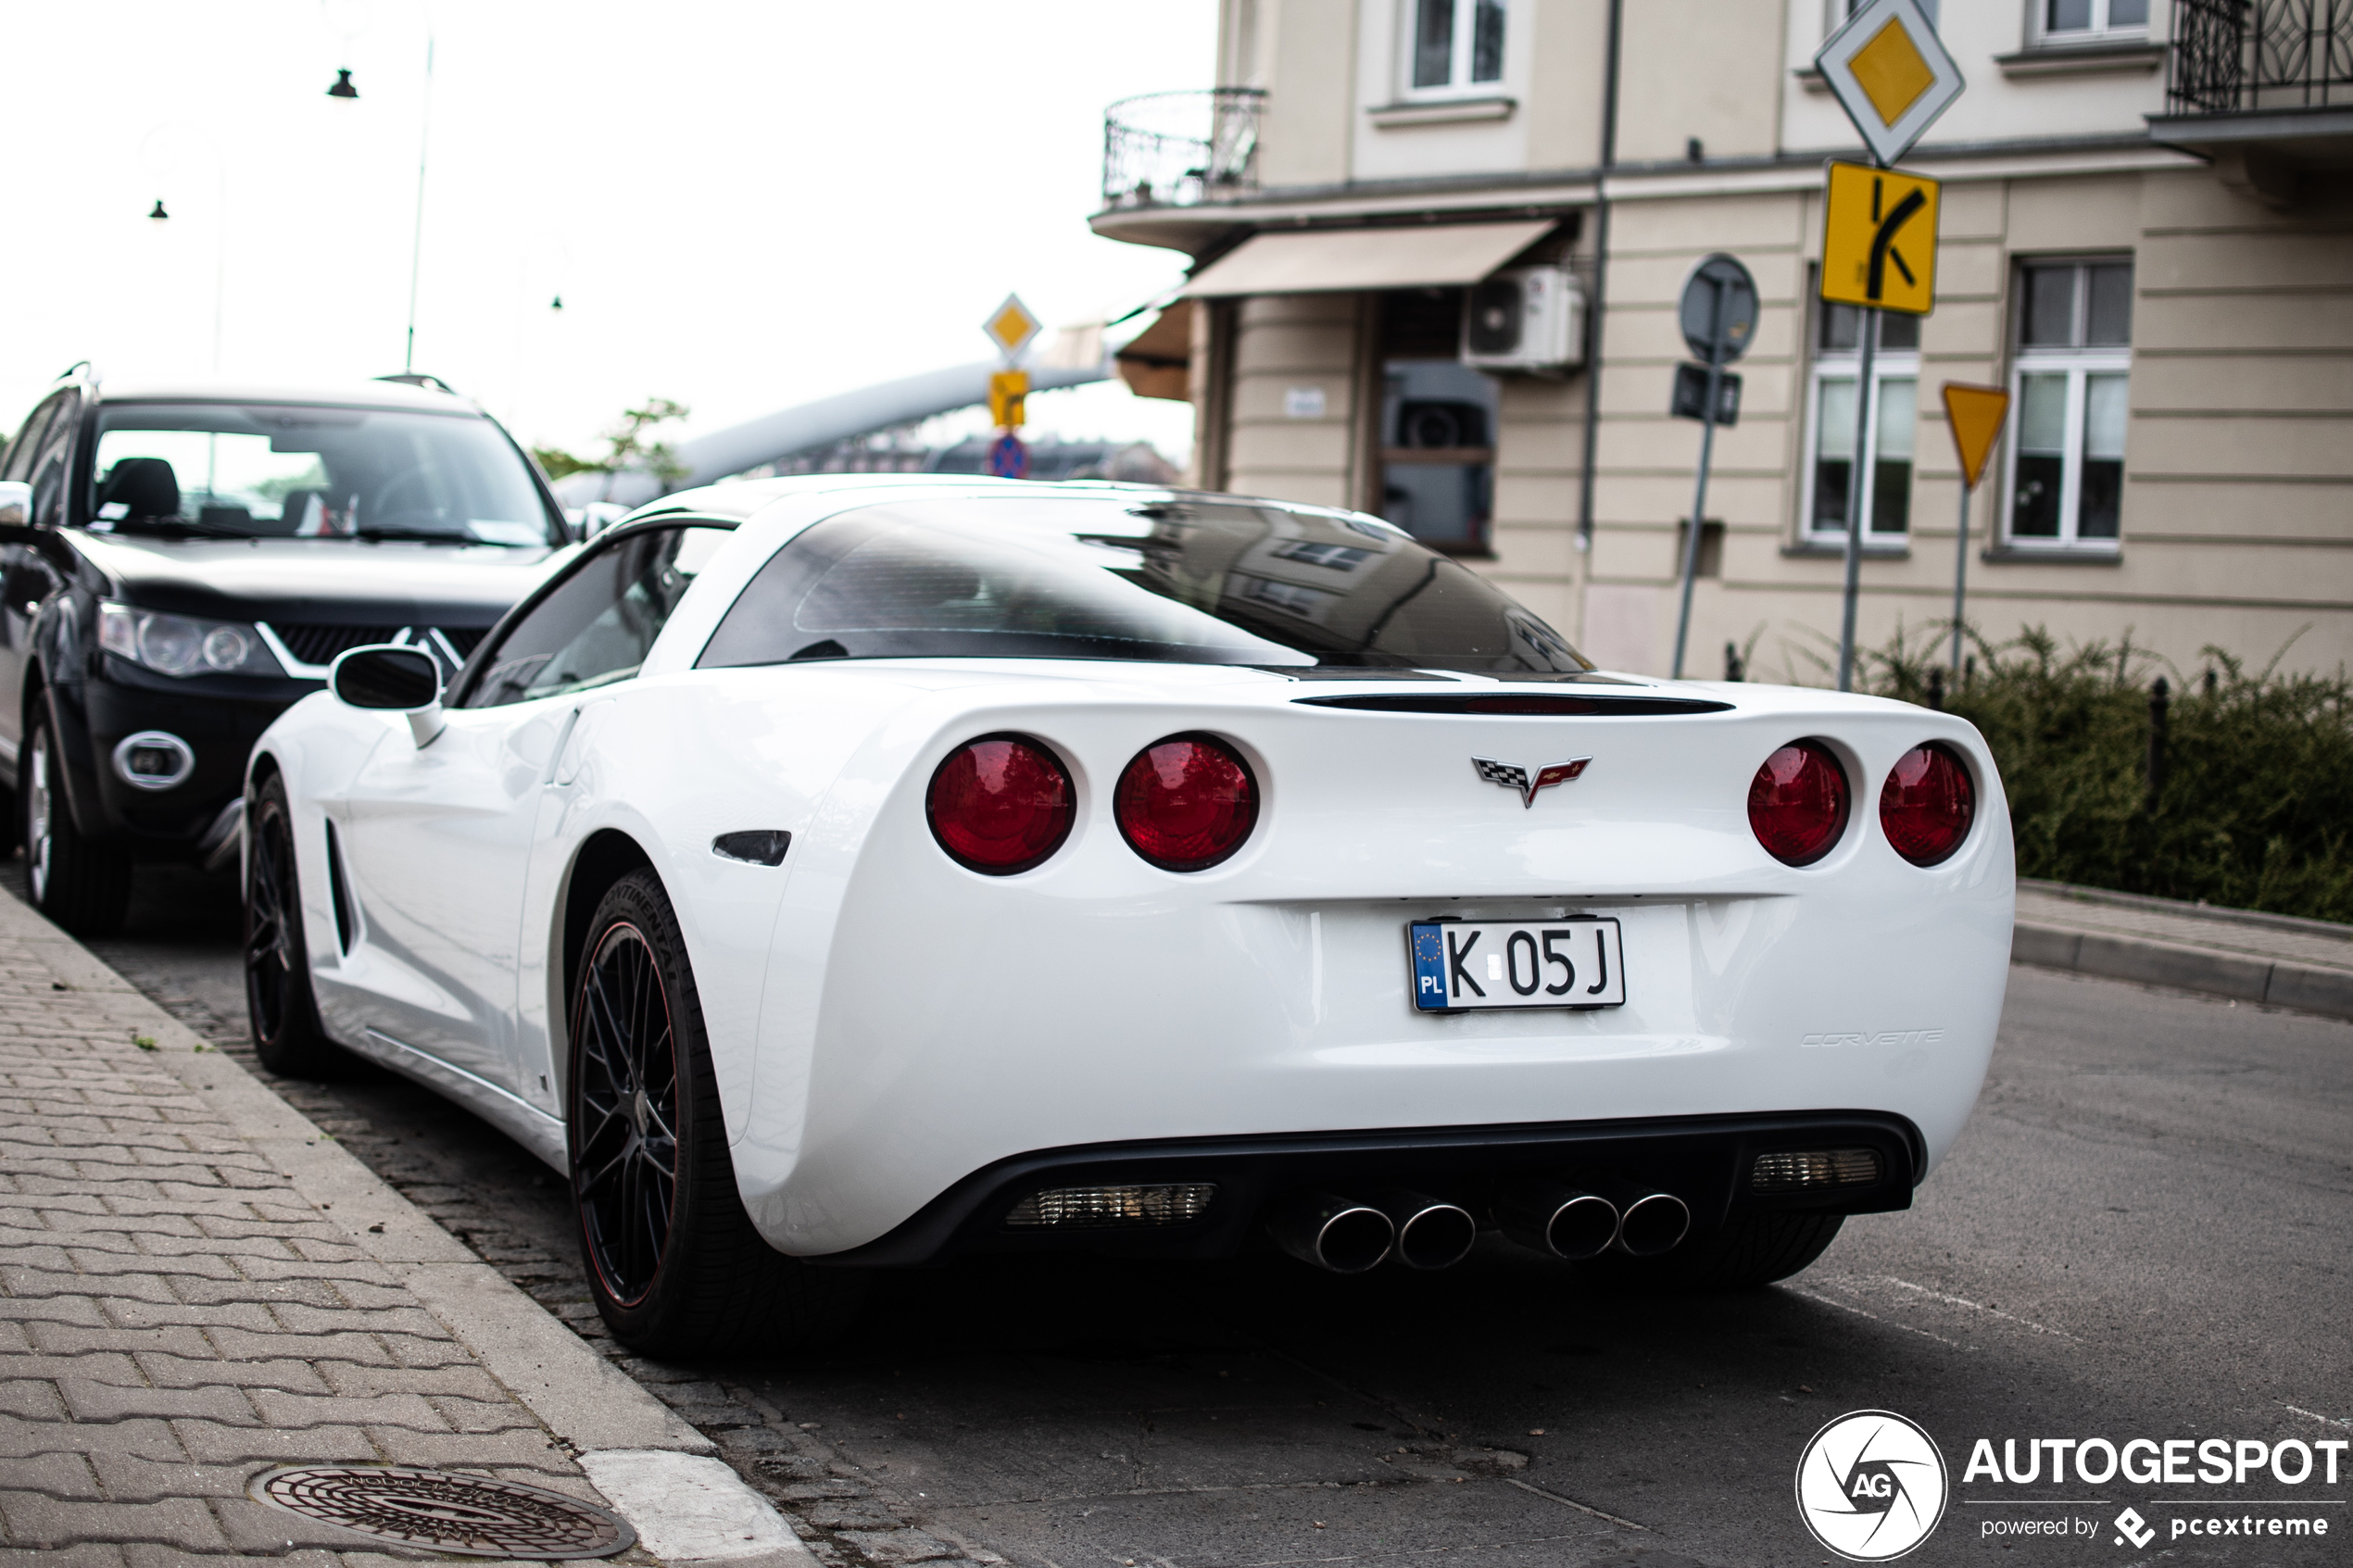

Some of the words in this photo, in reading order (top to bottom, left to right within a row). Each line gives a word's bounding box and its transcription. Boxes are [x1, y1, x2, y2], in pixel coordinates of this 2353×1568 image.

[1447, 930, 1487, 997] K
[1420, 975, 1443, 995] PL
[1801, 1028, 1944, 1047] CORVETTE
[355, 1513, 482, 1542] HYDRANT
